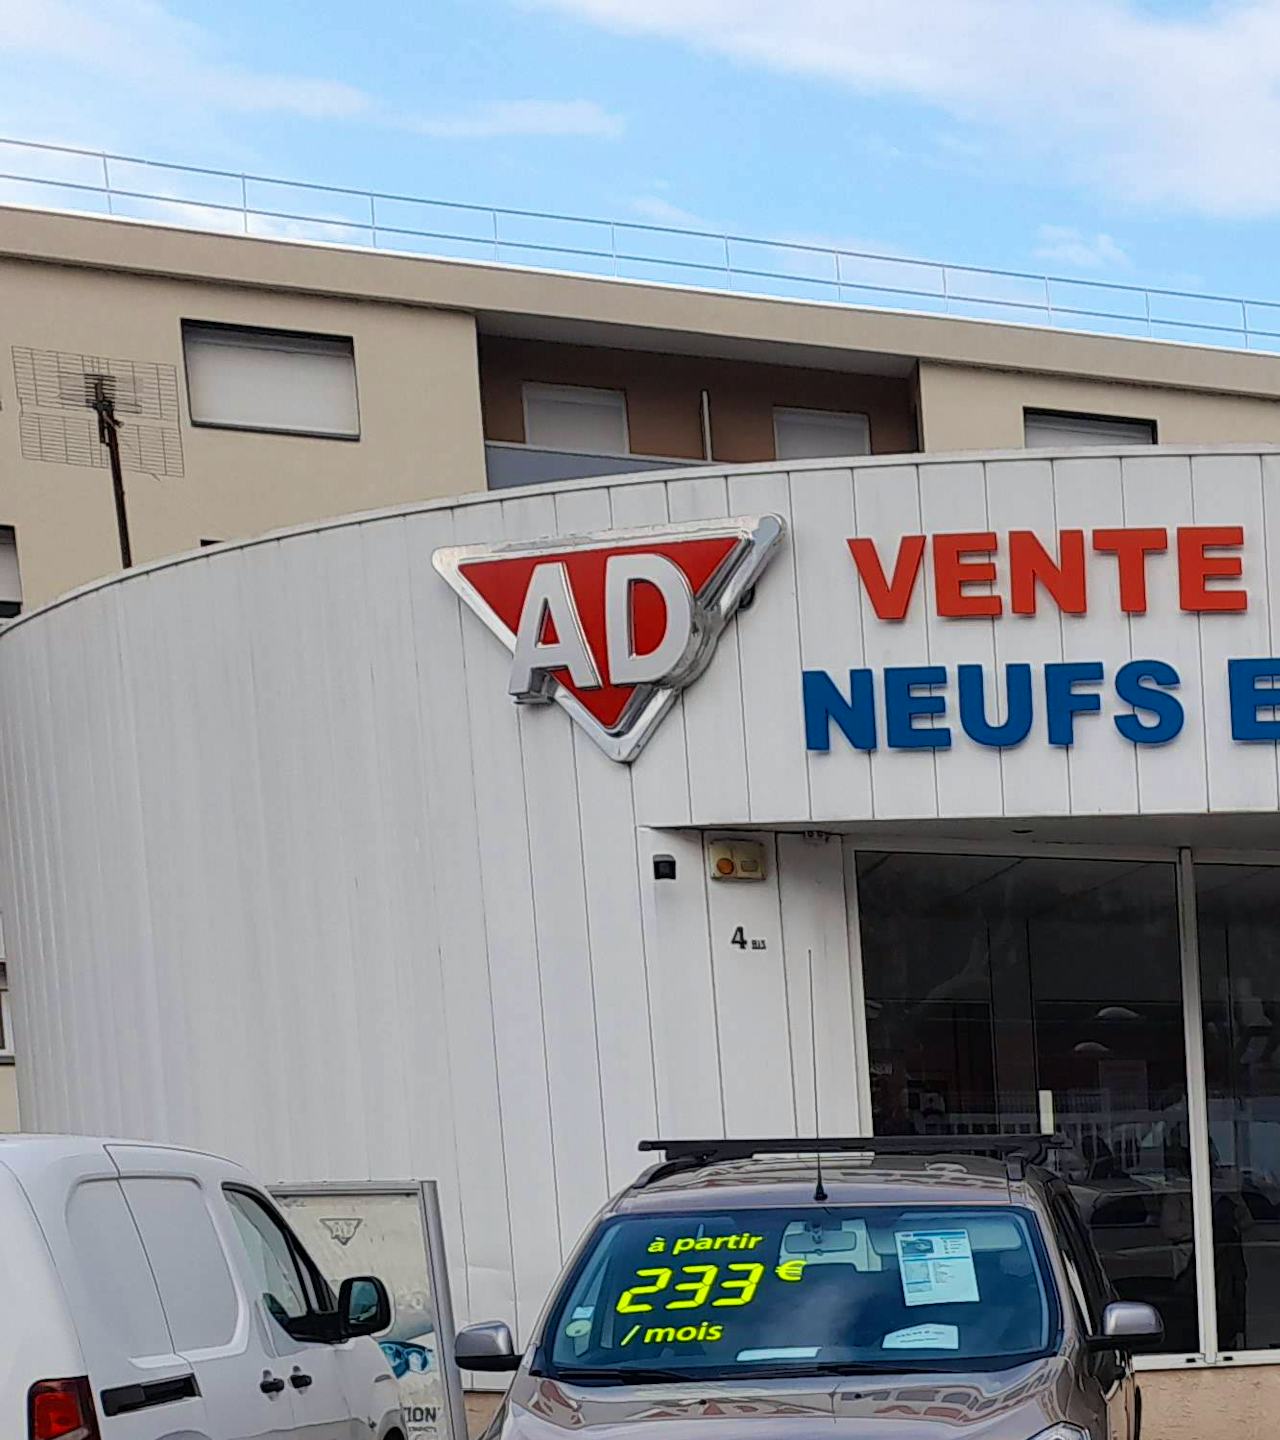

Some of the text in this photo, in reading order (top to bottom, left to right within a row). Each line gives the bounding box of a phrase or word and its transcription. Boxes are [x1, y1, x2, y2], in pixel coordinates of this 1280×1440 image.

[847, 525, 1248, 621] VENTE
[510, 553, 698, 698] AD
[802, 659, 1185, 752] NEUFS
[731, 926, 747, 950] 4
[647, 1232, 763, 1256] à partir
[643, 1321, 724, 1344] mois
